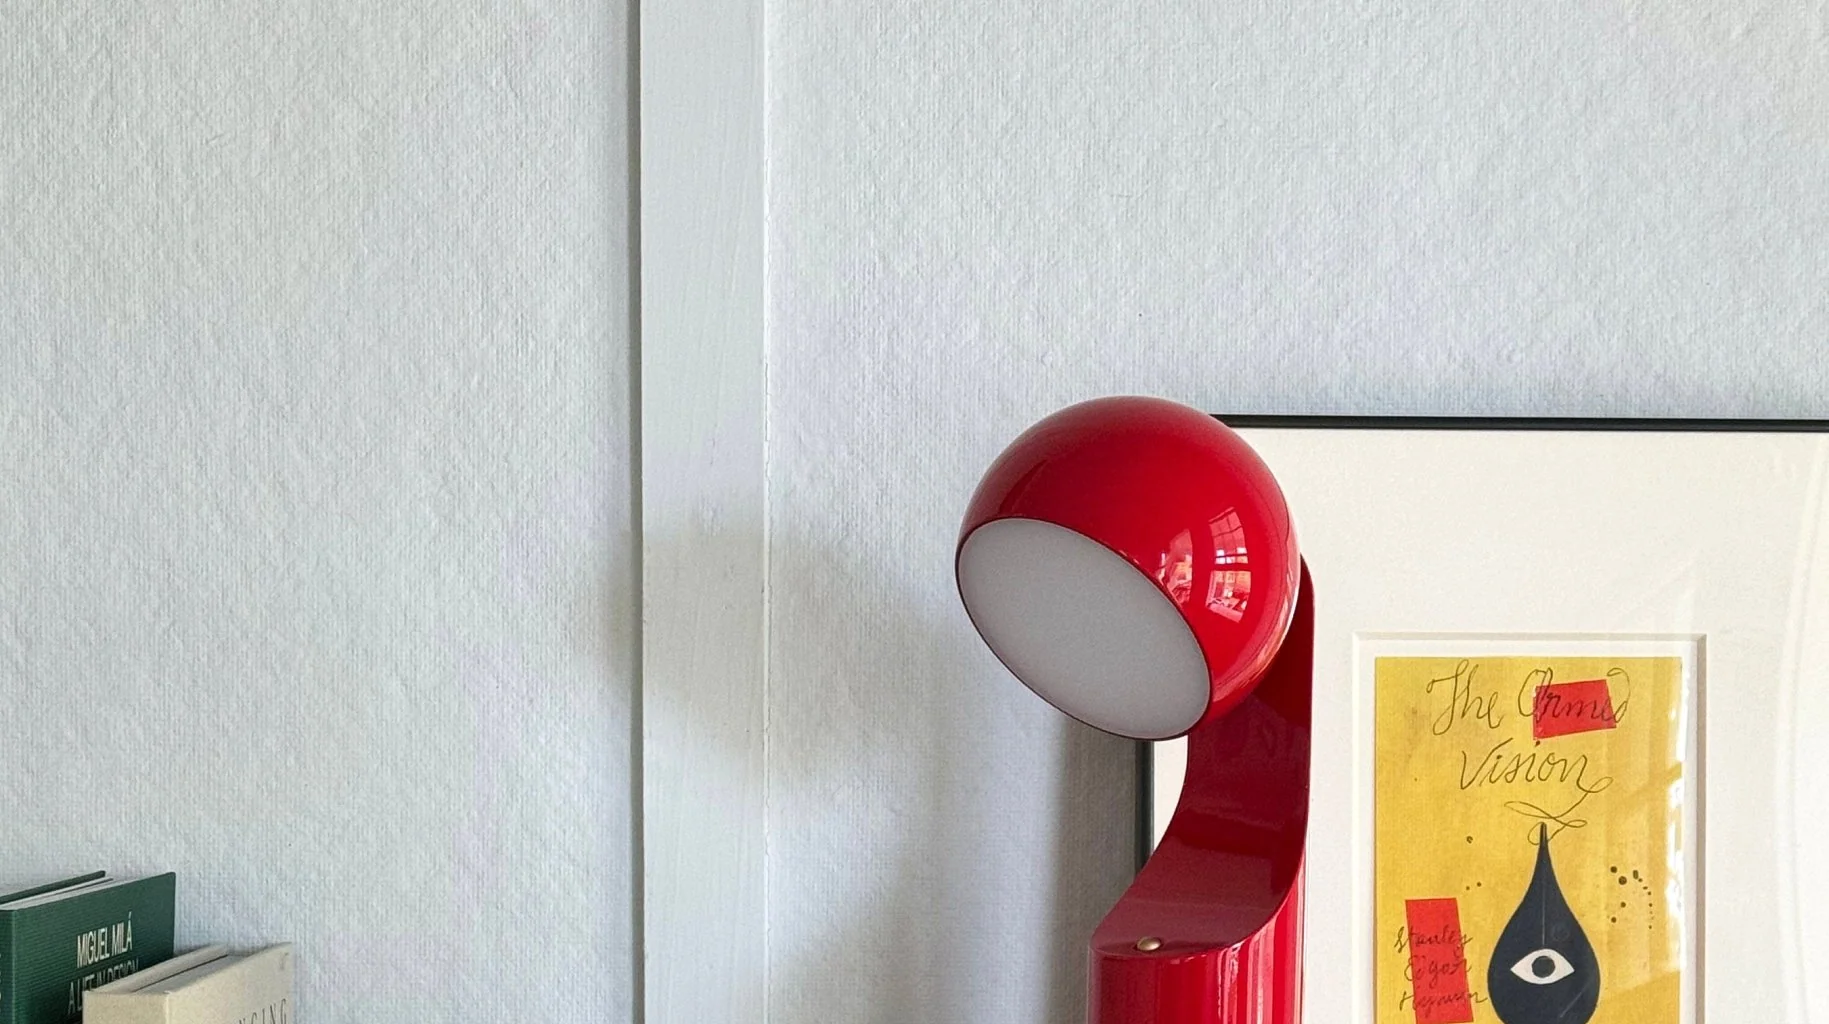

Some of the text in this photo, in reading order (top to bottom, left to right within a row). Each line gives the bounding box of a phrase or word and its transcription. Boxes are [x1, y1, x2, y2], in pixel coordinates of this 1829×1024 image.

[1425, 658, 1504, 735] The
[1460, 737, 1613, 793] Vision
[77, 911, 133, 968] MIGUEL MILÁ
